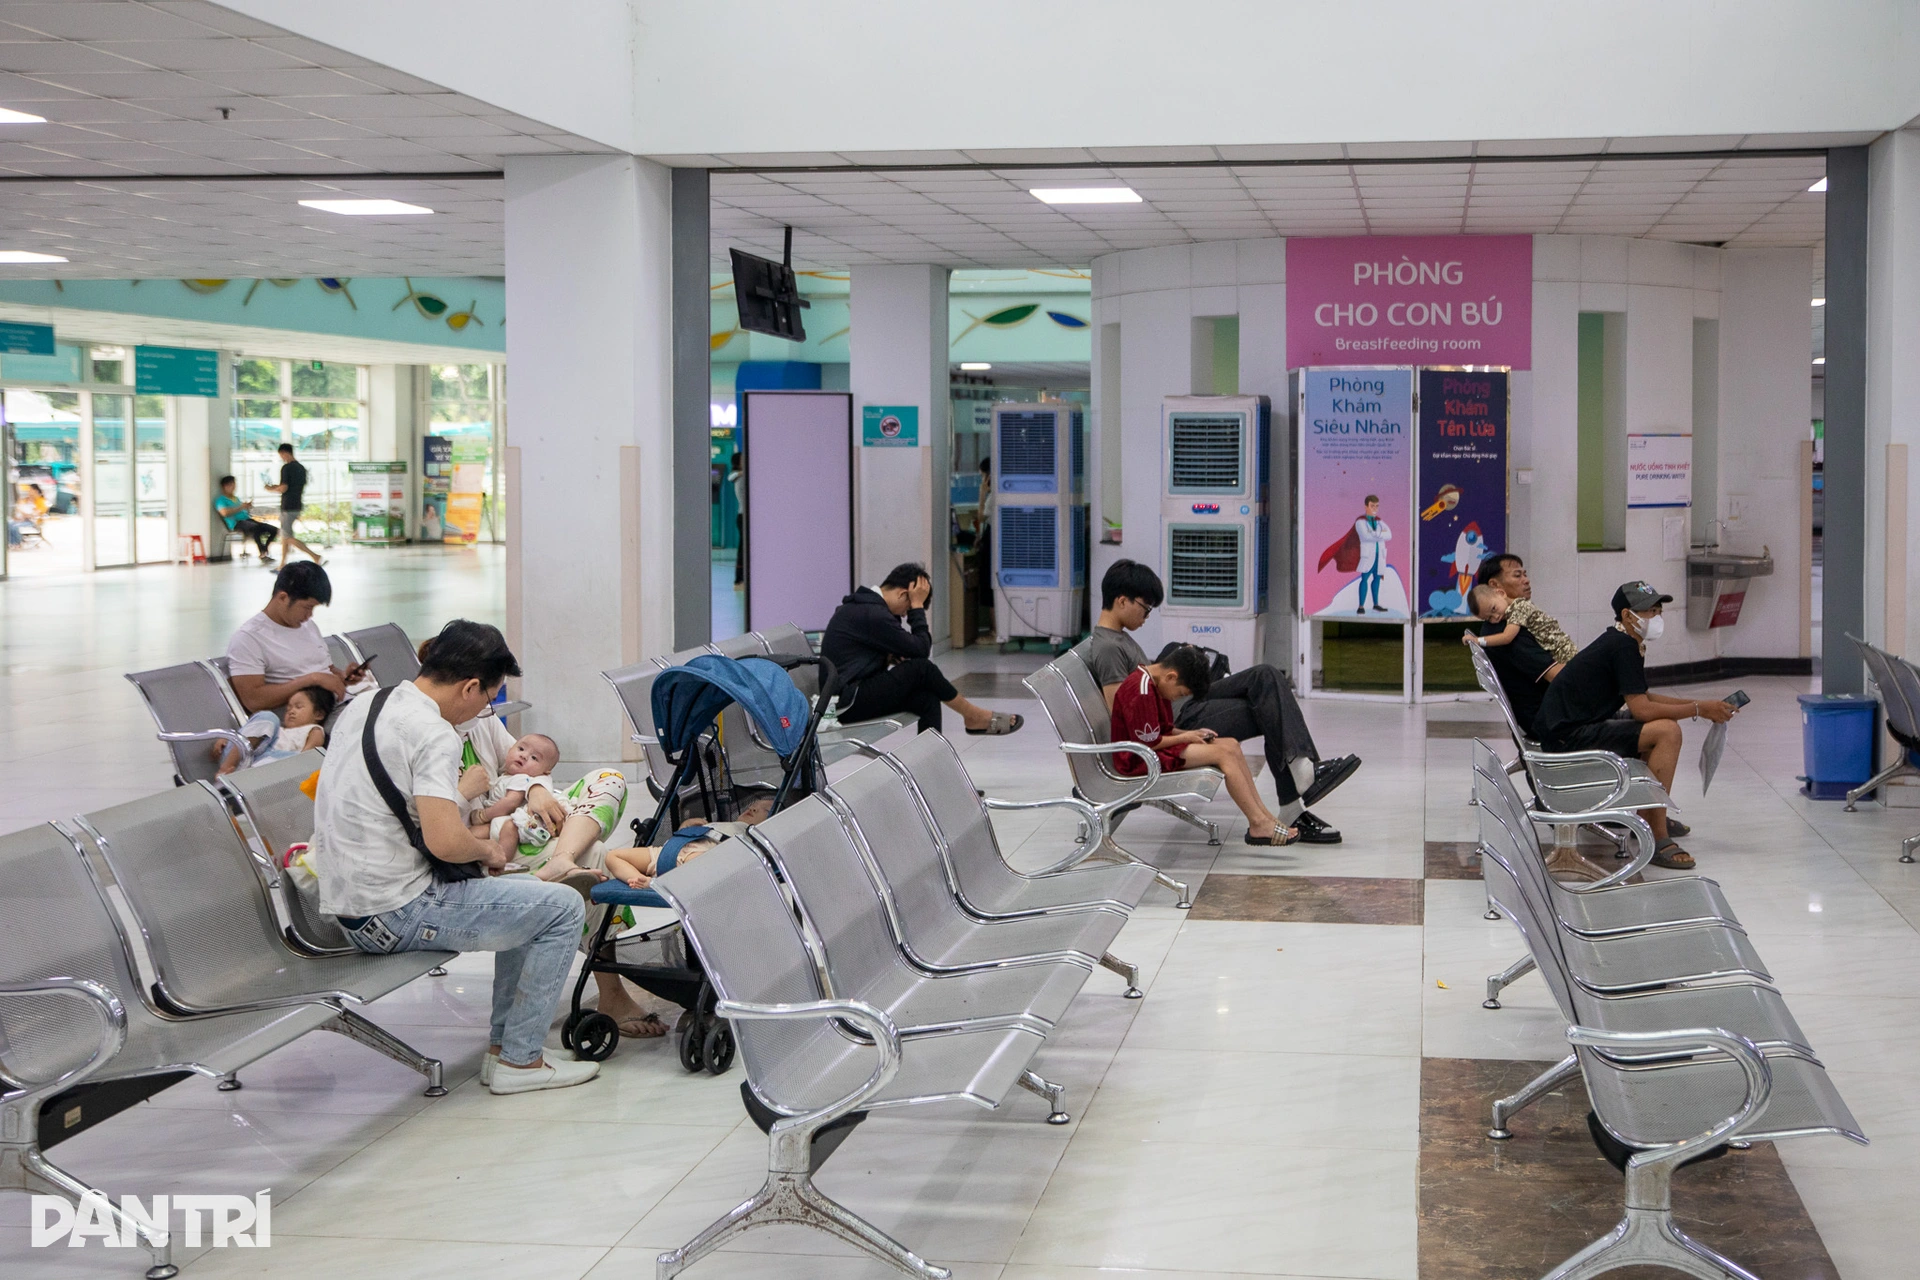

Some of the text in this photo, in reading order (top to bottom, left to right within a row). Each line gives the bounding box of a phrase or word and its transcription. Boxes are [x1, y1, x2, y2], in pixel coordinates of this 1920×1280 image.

[1353, 255, 1463, 286] PHÒNG
[1314, 295, 1503, 327] CHO CON BÚ
[1335, 337, 1481, 353] Breastfeeding room
[1329, 377, 1385, 396] Phòng
[1442, 377, 1491, 397] Phòng
[1332, 398, 1382, 413] Khám
[1444, 399, 1489, 416] Khám
[1313, 418, 1401, 434] Siêu Nhân
[1437, 418, 1496, 437] Tên Lửa
[1191, 625, 1222, 634] DAIKIO
